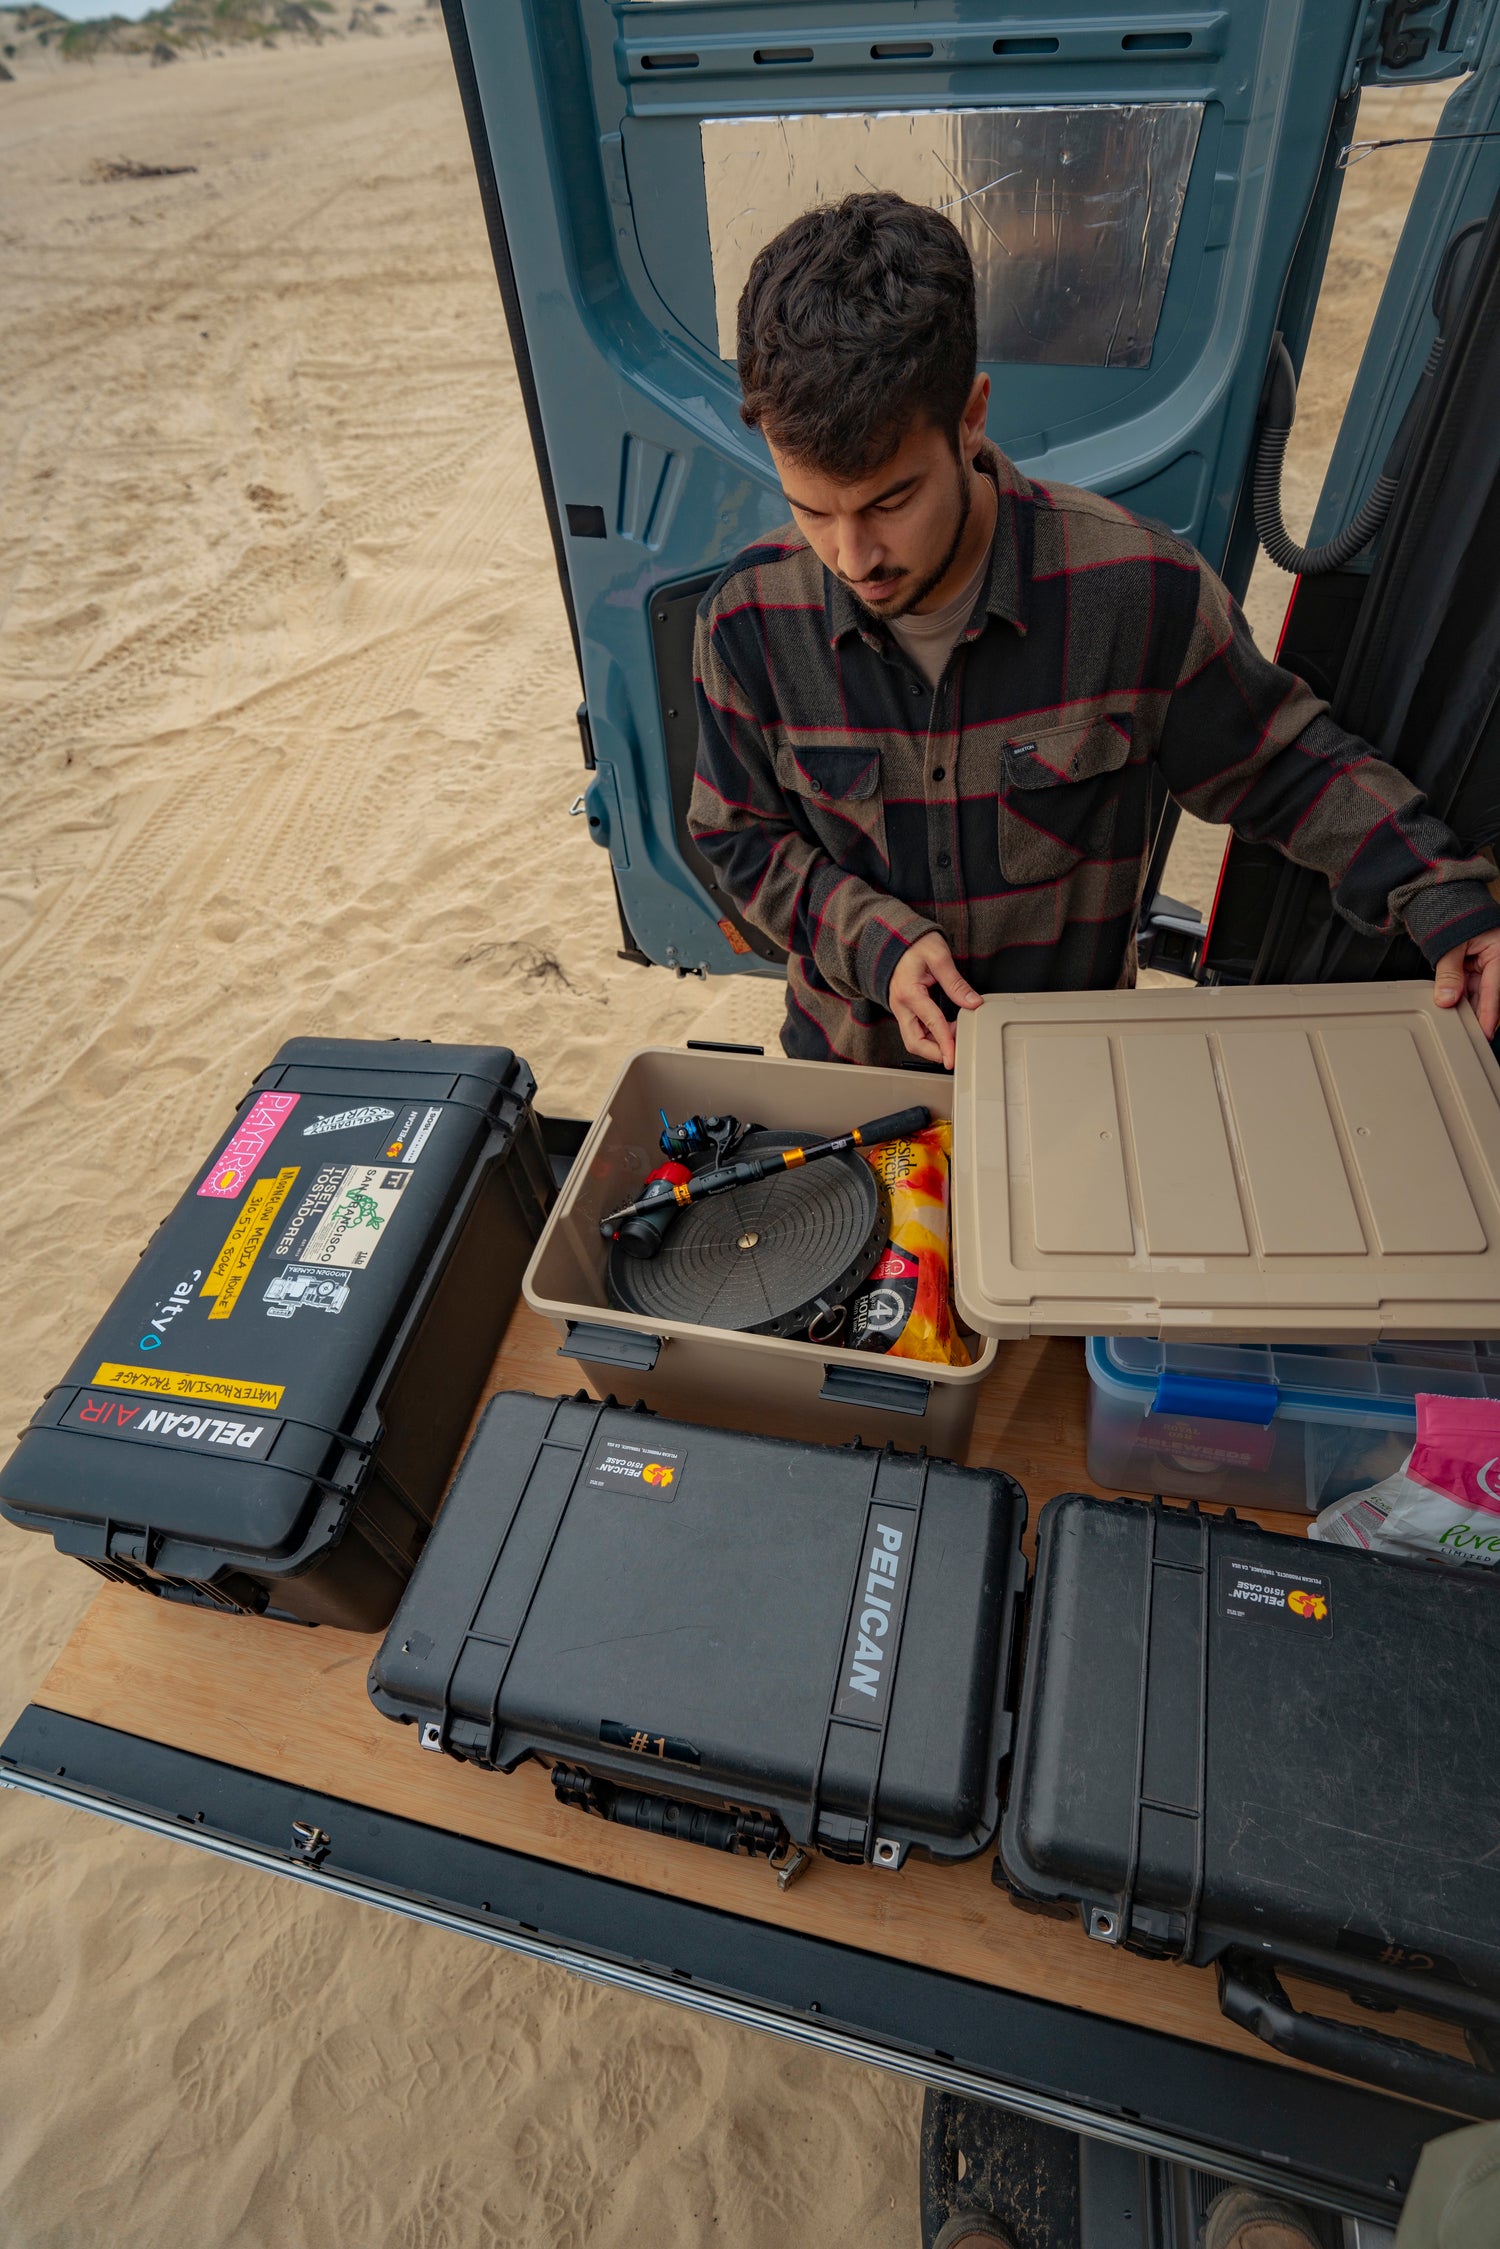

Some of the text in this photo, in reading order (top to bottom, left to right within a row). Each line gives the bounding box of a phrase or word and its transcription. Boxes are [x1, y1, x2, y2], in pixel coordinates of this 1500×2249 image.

[311, 1115, 384, 1135] SOLIDARITY
[312, 1107, 382, 1128] SURFING
[397, 1110, 419, 1142] PELICAN
[308, 1167, 347, 1216] TUSELL
[357, 1169, 377, 1194] SAN
[275, 1166, 332, 1256] TOSTADORES
[320, 1193, 366, 1263] FRANCISCO
[237, 1227, 264, 1269] MEDIA
[288, 1265, 349, 1278] WOODEN CAMERA
[218, 1275, 243, 1307] HOUSE
[857, 1294, 869, 1332] HOUR
[109, 1371, 172, 1391] PACKAGE
[79, 1398, 264, 1449] PELICAN AIR
[1163, 1423, 1201, 1436] ROYAL
[599, 1463, 643, 1478] PELICAN
[605, 1456, 645, 1470] 1510 CASE
[1438, 1524, 1500, 1552] Pure
[1440, 1547, 1492, 1563] LIMITED
[1236, 1580, 1286, 1597] 1510 CASE
[1302, 1575, 1322, 1585] PELICAN
[849, 1523, 903, 1698] PELICAN
[1233, 1589, 1286, 1608] PELICAN
[629, 1731, 666, 1759] #1
[1379, 1946, 1435, 1972] #2
